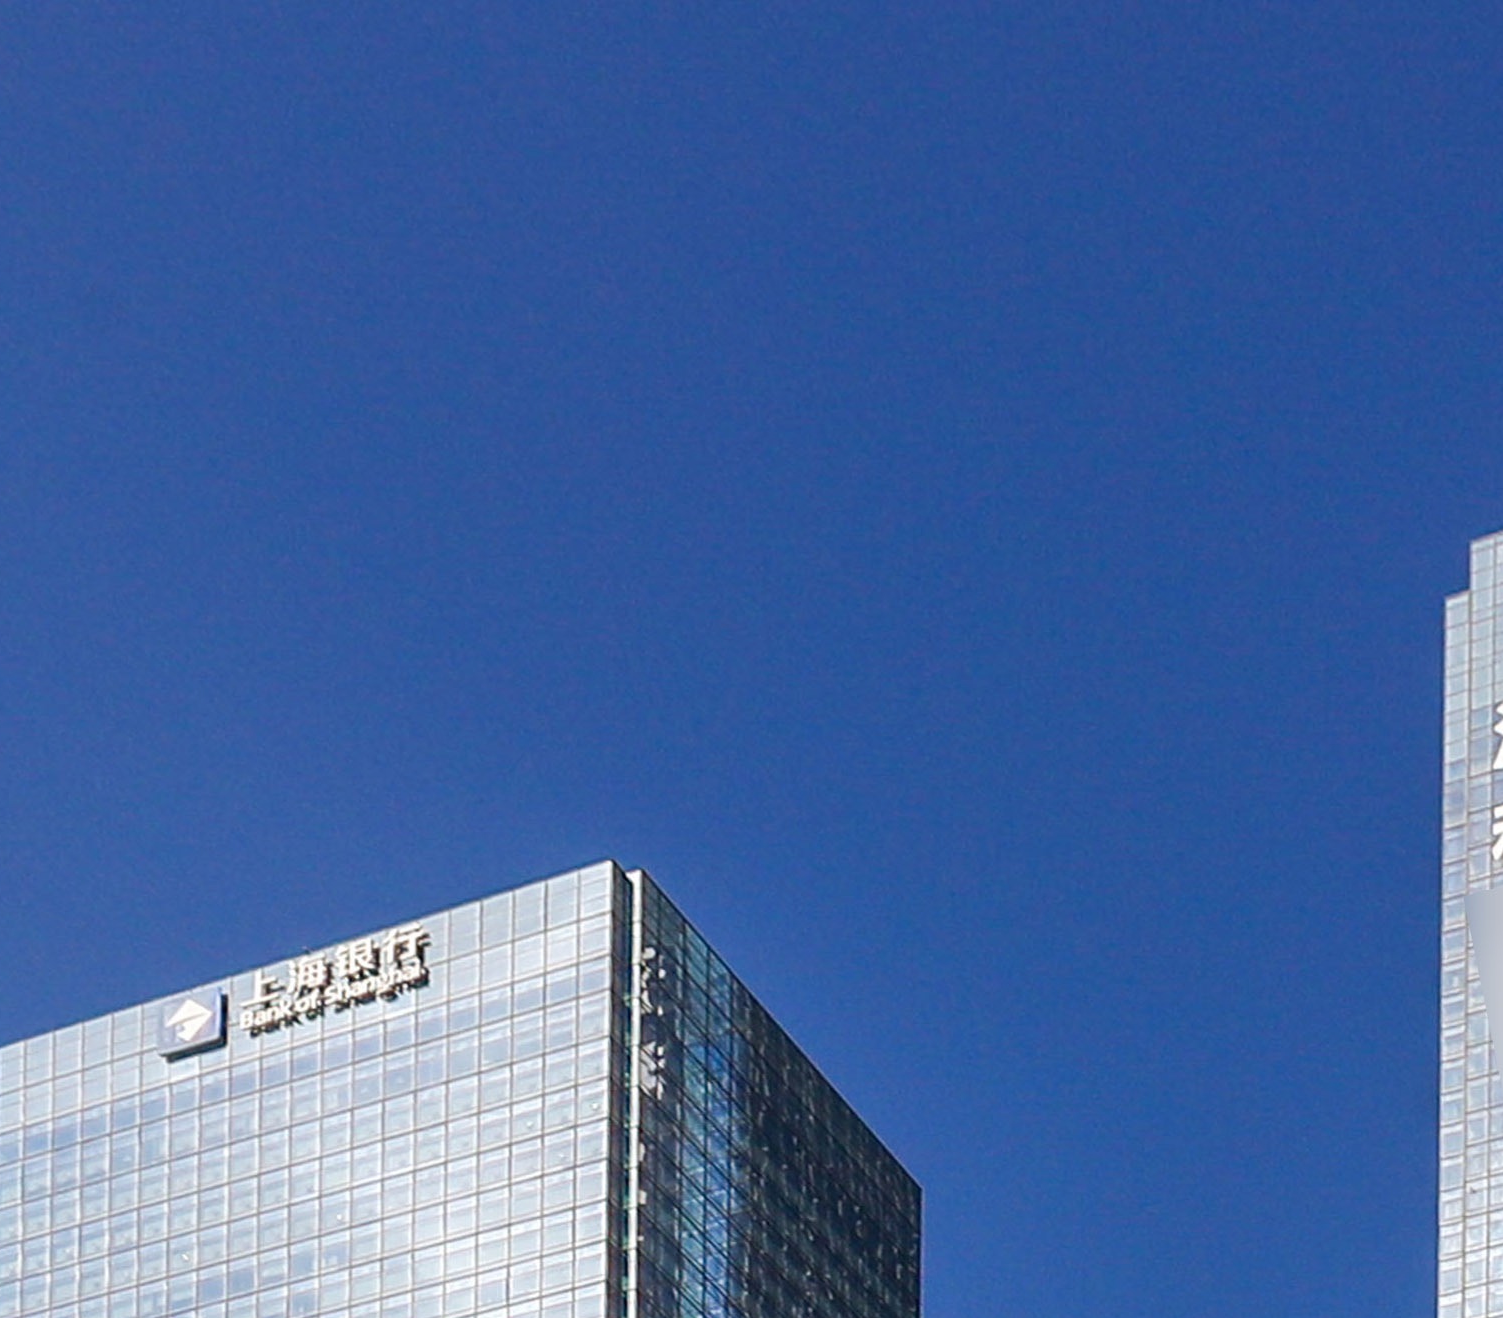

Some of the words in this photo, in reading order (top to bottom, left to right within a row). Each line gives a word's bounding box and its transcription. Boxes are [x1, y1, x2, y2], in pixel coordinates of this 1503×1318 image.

[240, 921, 423, 1009] 上海银行
[239, 996, 293, 1029] Bank
[293, 986, 322, 1013] of
